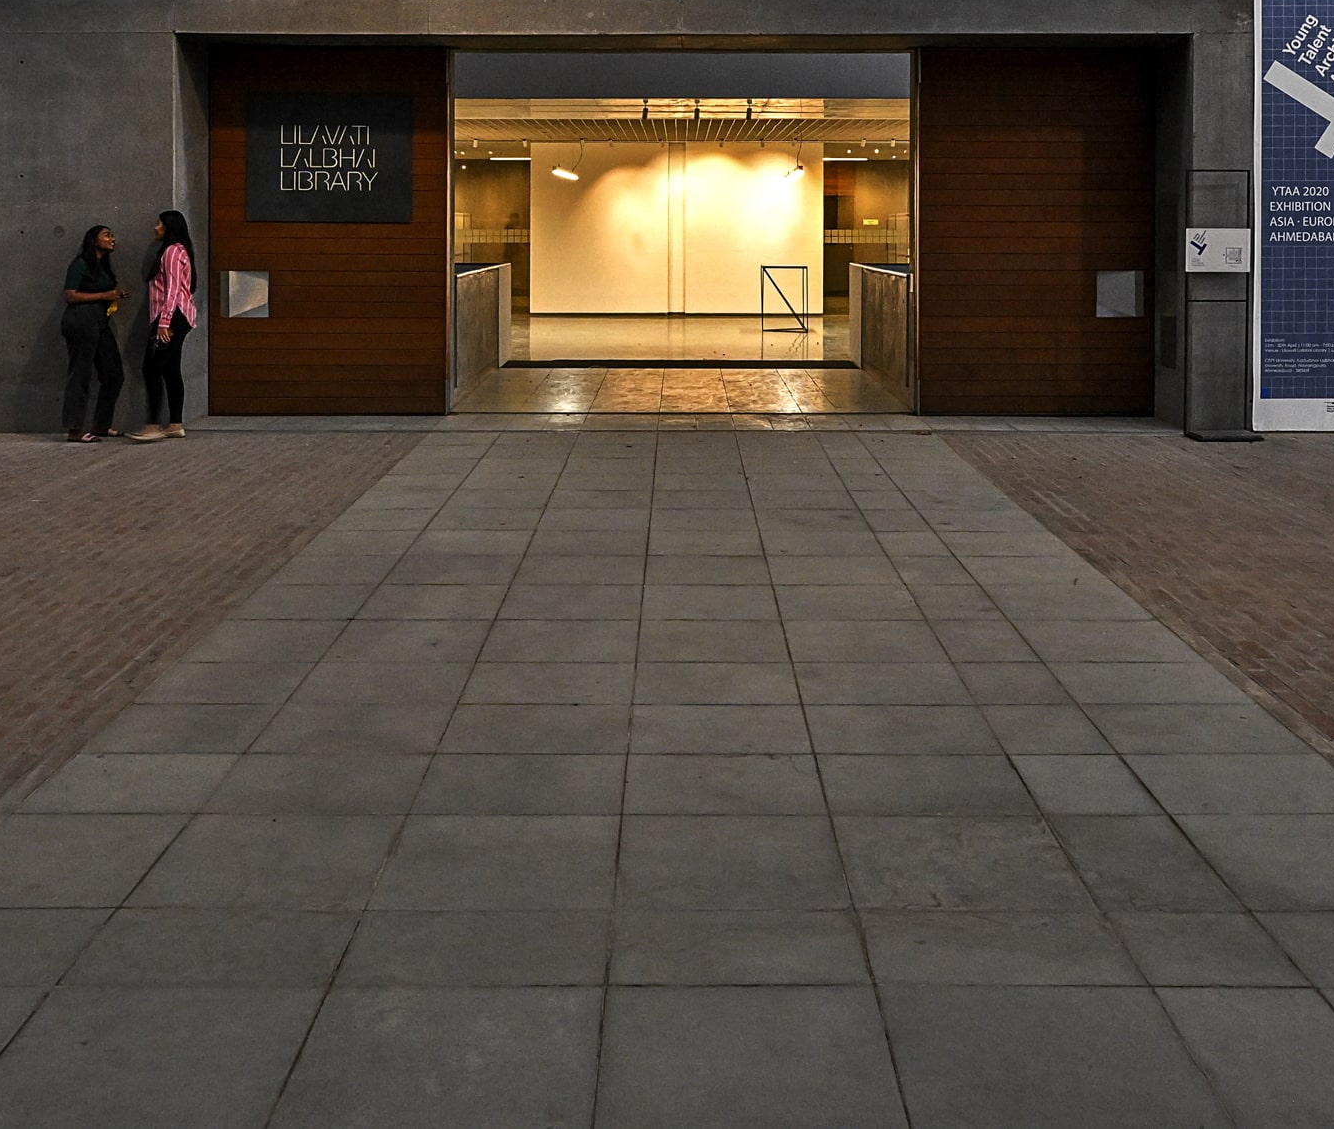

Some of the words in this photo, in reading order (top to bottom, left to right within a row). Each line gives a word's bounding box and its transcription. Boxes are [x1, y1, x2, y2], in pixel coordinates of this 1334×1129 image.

[1282, 14, 1319, 55] Young
[1297, 24, 1332, 65] Talent
[280, 124, 370, 145] LILAVATI
[280, 148, 376, 169] LALBHAI
[280, 169, 379, 192] LIBRARY
[1271, 186, 1300, 197] YTAA
[1302, 186, 1330, 197] 2020
[1269, 201, 1332, 212] EXHIBITION
[1269, 216, 1295, 227] ASIA
